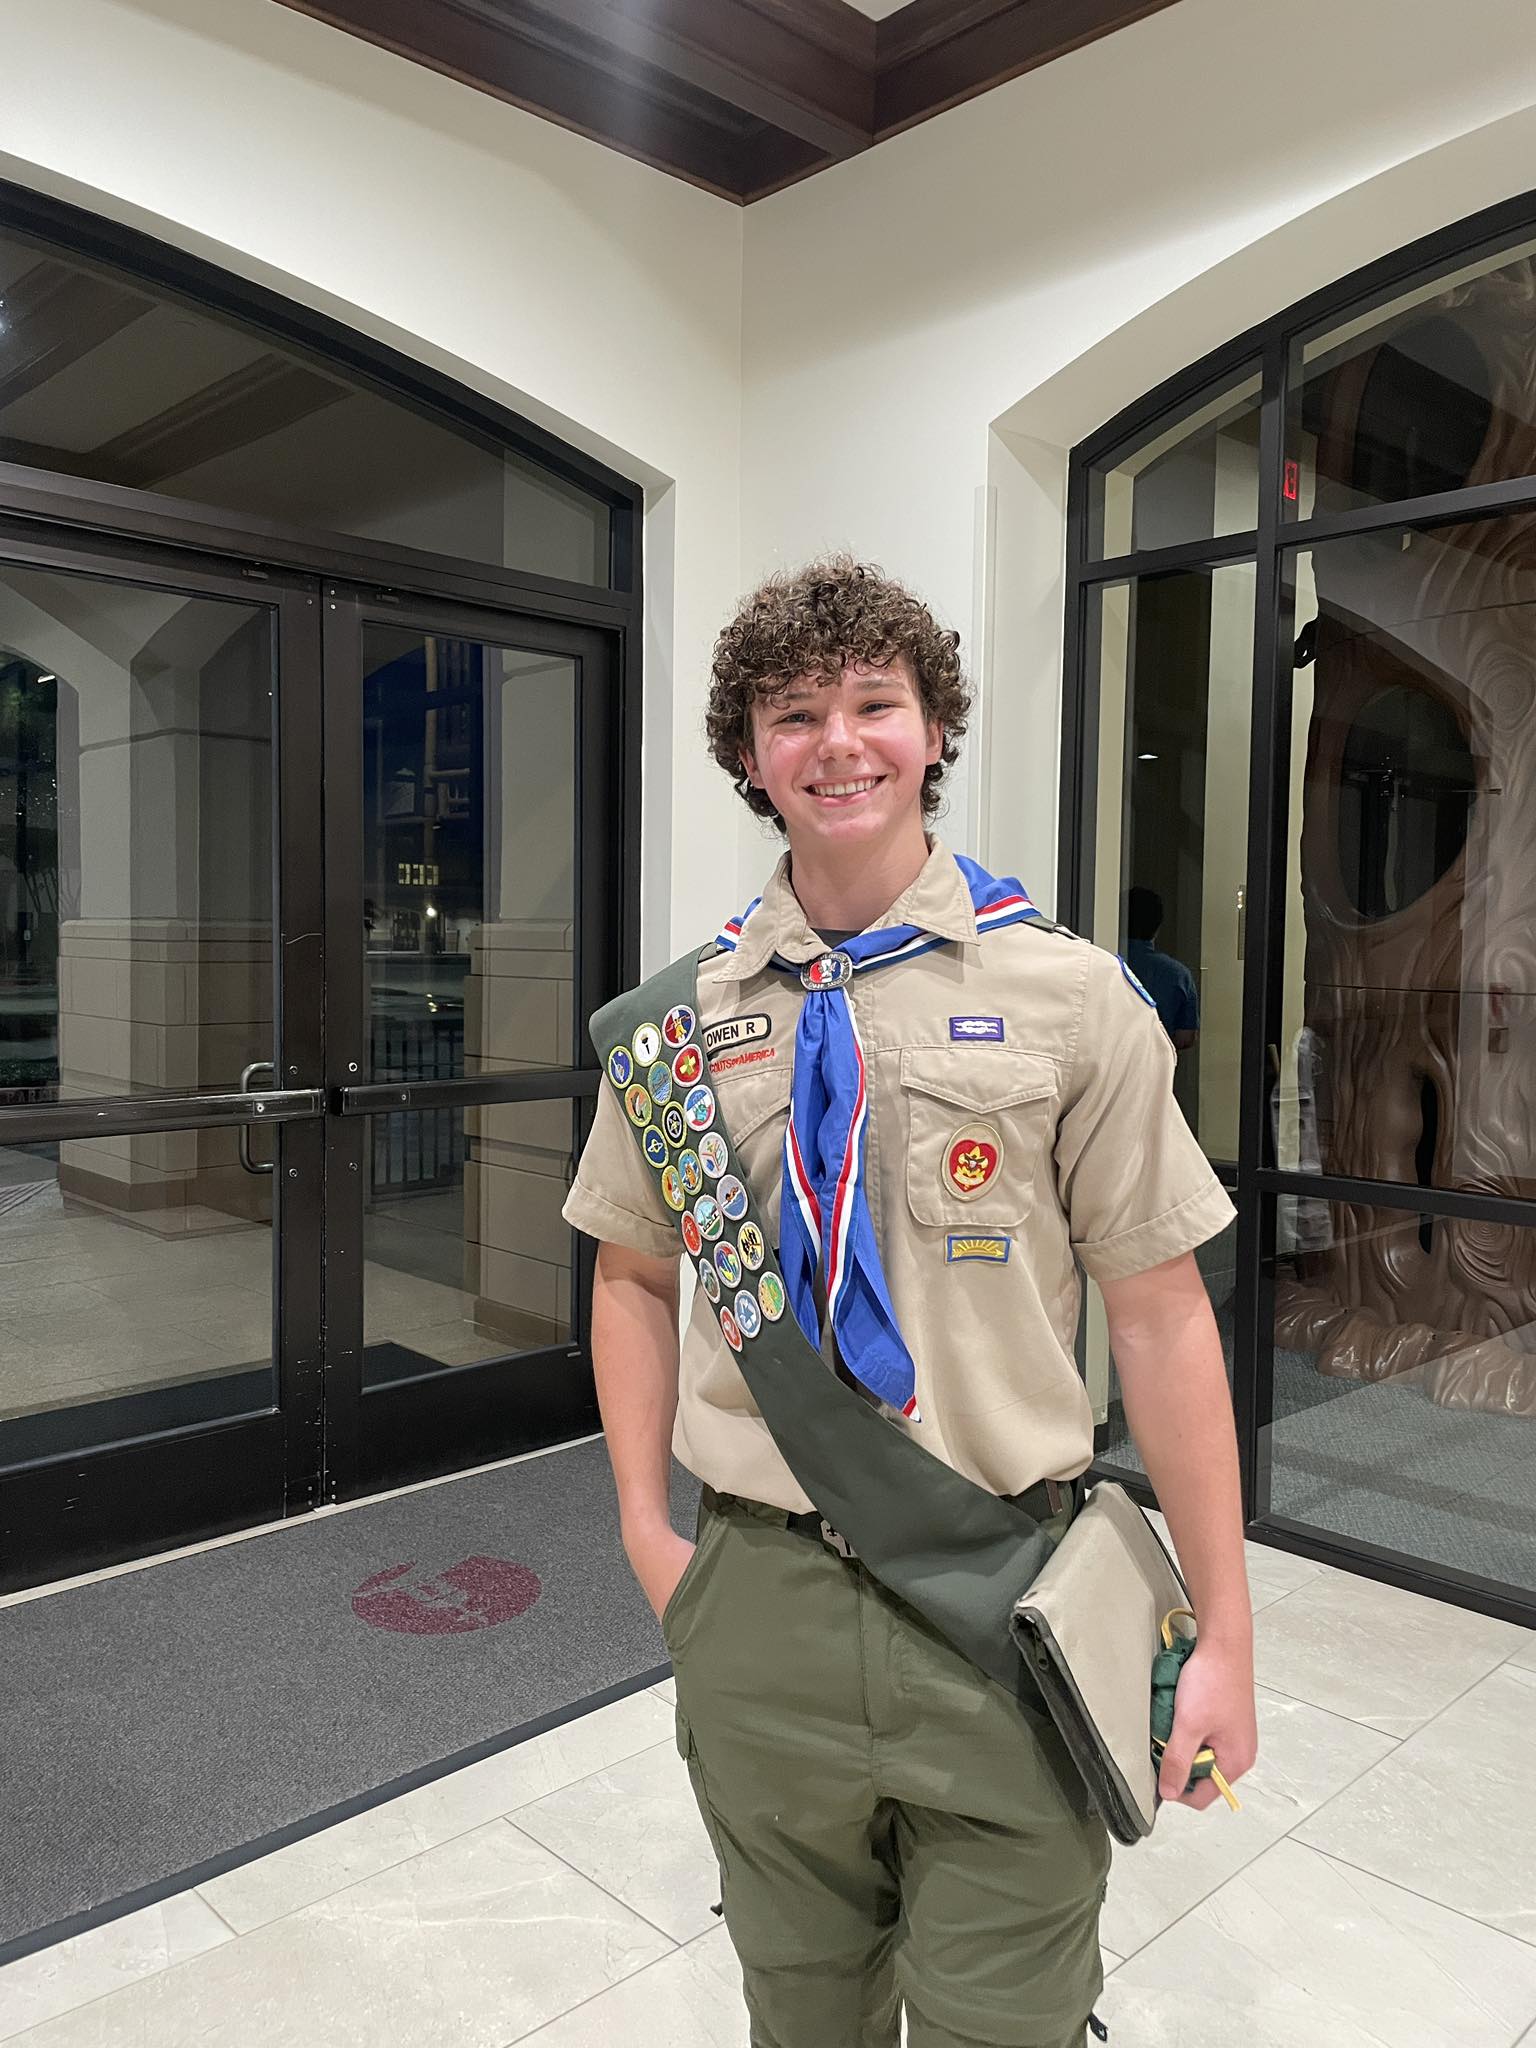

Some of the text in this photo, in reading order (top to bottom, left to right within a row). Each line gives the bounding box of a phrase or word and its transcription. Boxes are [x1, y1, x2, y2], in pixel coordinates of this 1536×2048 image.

[706, 1021, 756, 1047] OWEN R
[709, 1057, 733, 1073] COUTS
[738, 1048, 775, 1064] AMERICA
